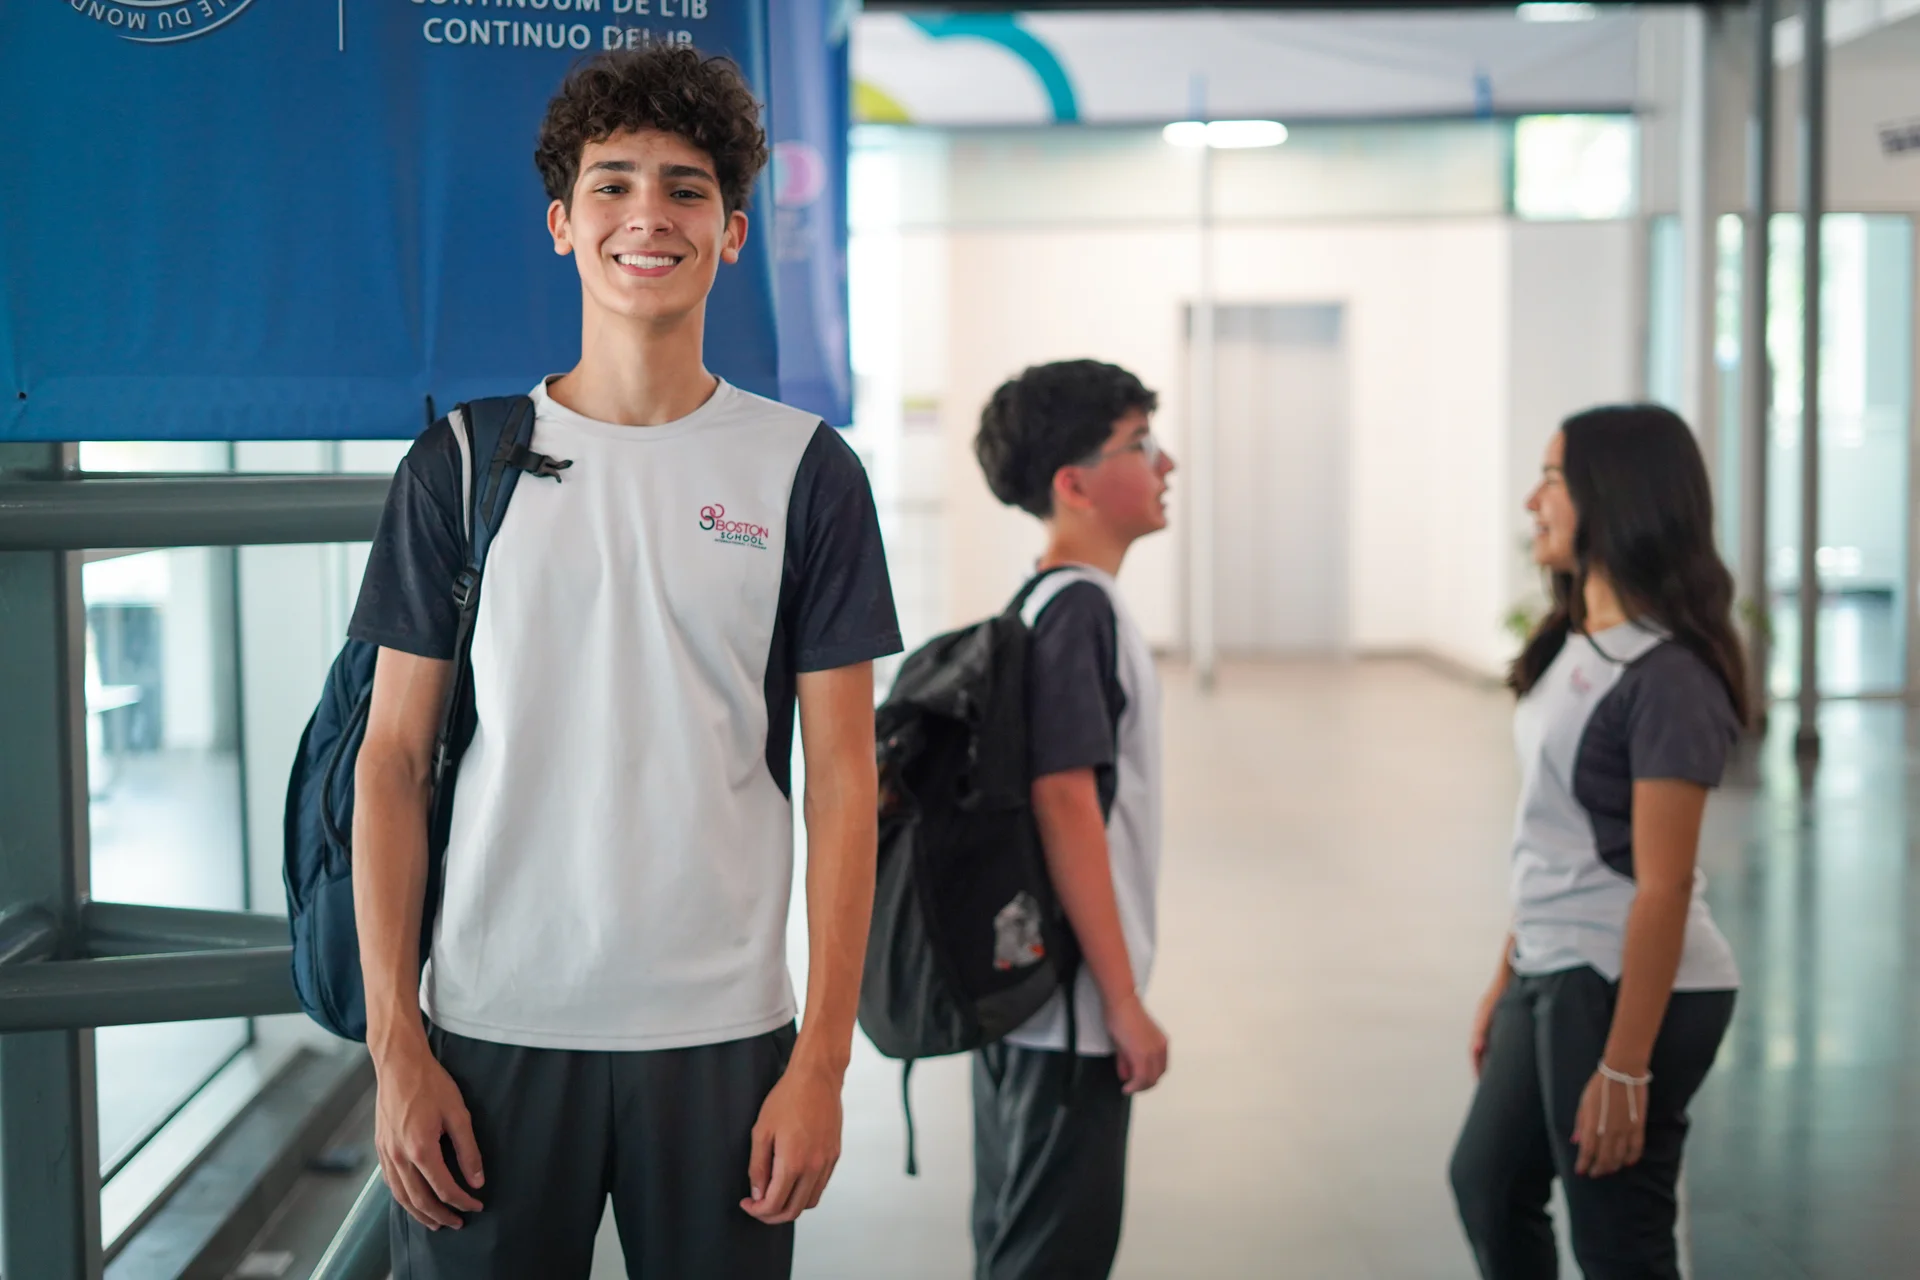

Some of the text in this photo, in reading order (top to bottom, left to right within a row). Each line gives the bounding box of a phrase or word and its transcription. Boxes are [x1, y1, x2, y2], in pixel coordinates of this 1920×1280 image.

[71, 0, 146, 30] MOND
[158, 7, 192, 29] DU
[660, 0, 708, 20] LIB
[423, 17, 591, 50] CONTINUO
[715, 519, 769, 539] BOSTON
[720, 531, 764, 546] SCHOOL
